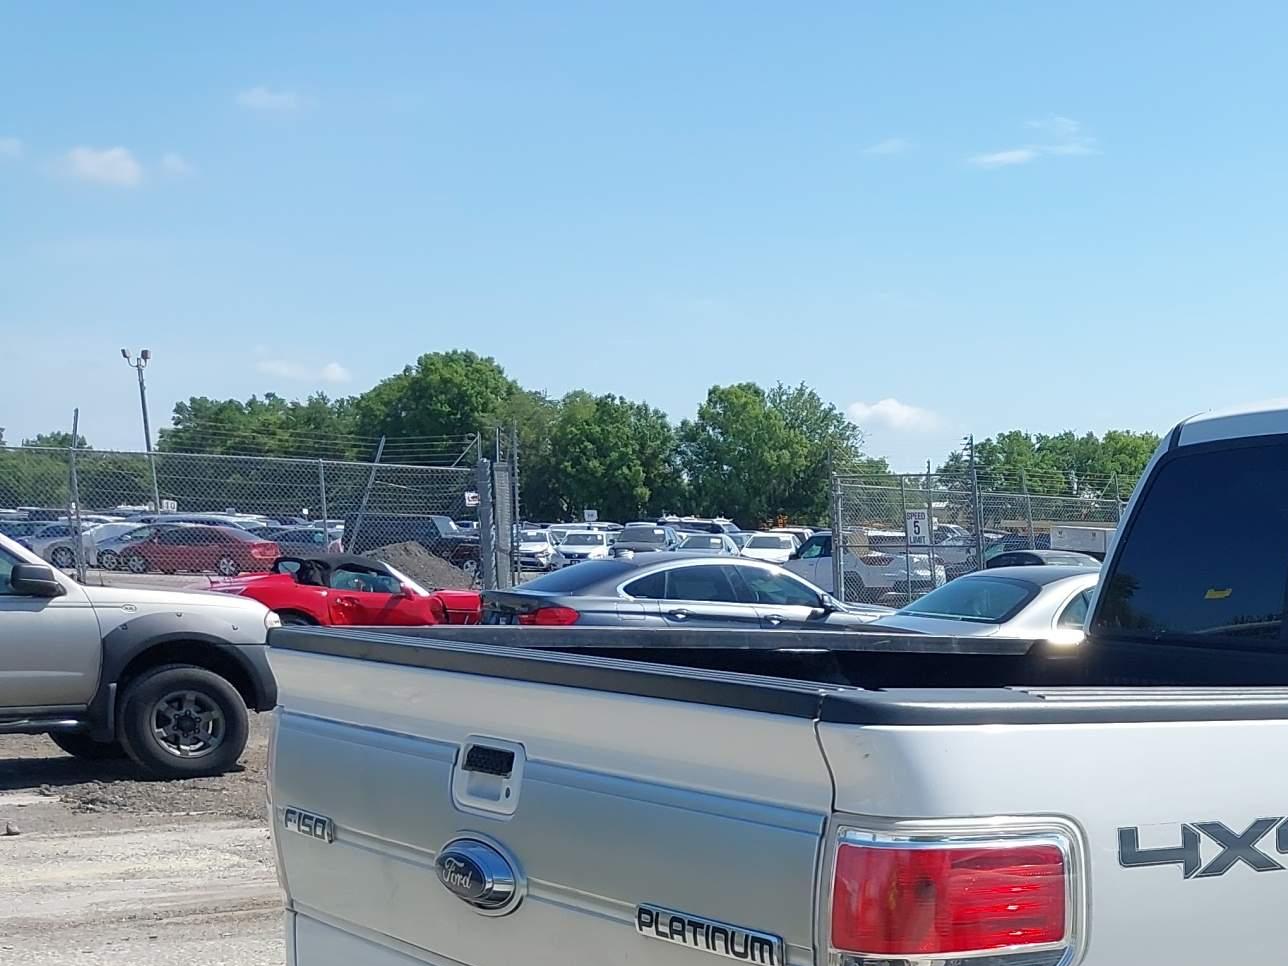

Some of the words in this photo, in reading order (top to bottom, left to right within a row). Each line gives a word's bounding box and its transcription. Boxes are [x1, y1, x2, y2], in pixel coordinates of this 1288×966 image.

[906, 511, 926, 520] SPEED
[913, 520, 921, 535] 5
[910, 536, 926, 545] LIMIT
[442, 857, 473, 889] Ford
[637, 906, 776, 966] PLATINUM
